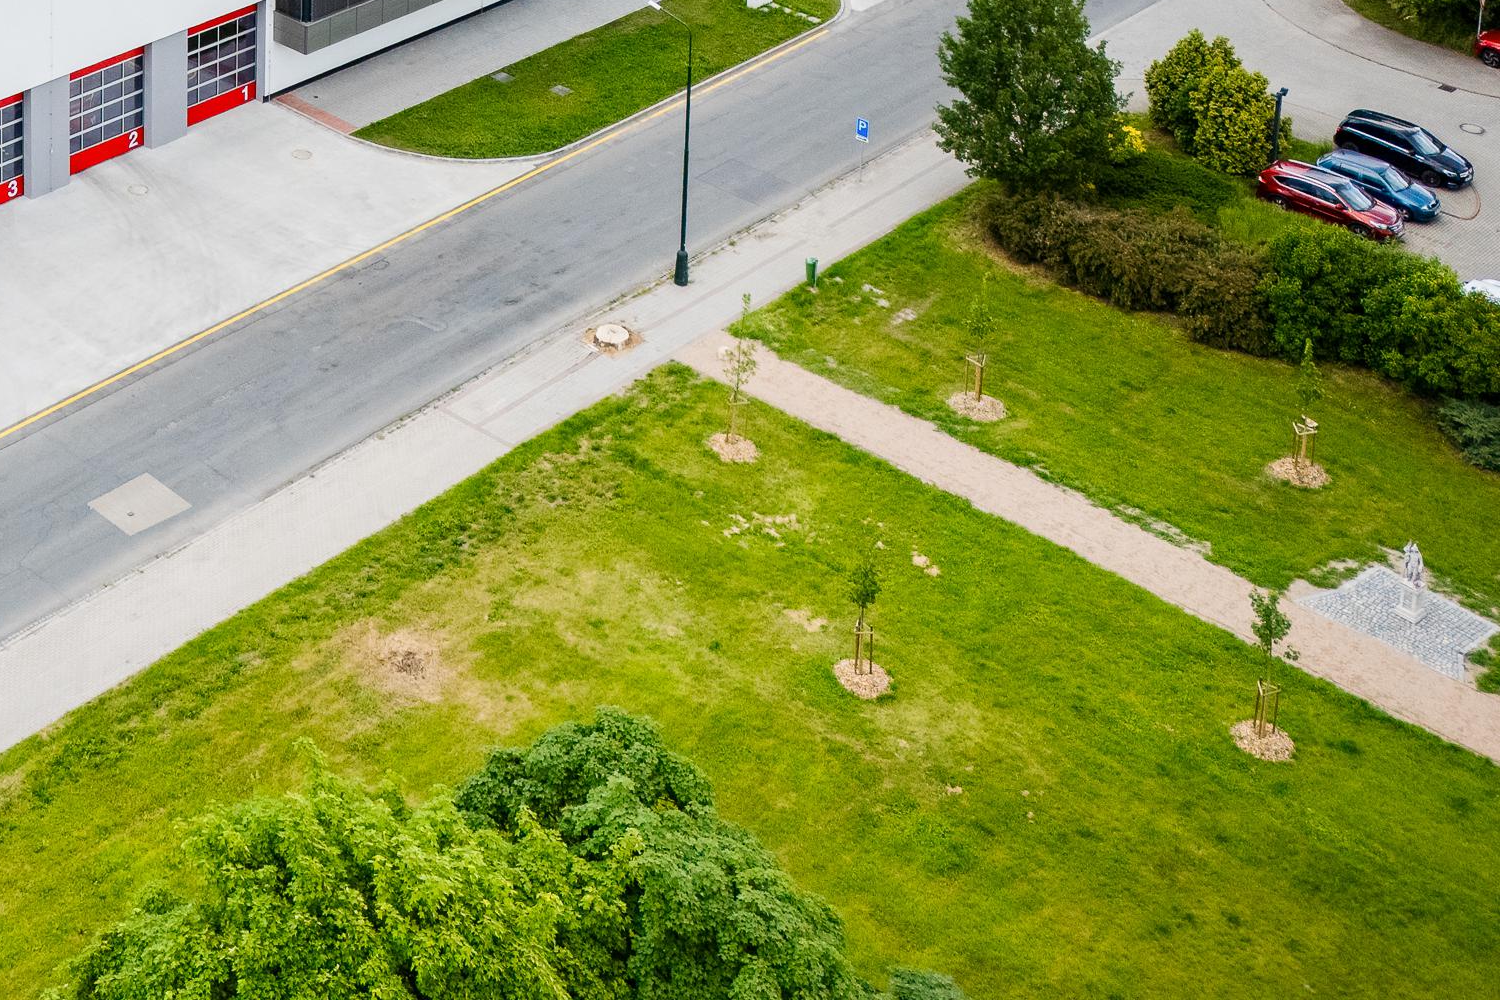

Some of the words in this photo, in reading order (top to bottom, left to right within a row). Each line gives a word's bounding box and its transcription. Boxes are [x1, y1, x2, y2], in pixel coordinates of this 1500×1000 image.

[241, 85, 249, 101] 1
[858, 120, 867, 131] P
[128, 130, 139, 149] 2
[7, 180, 18, 198] 3
